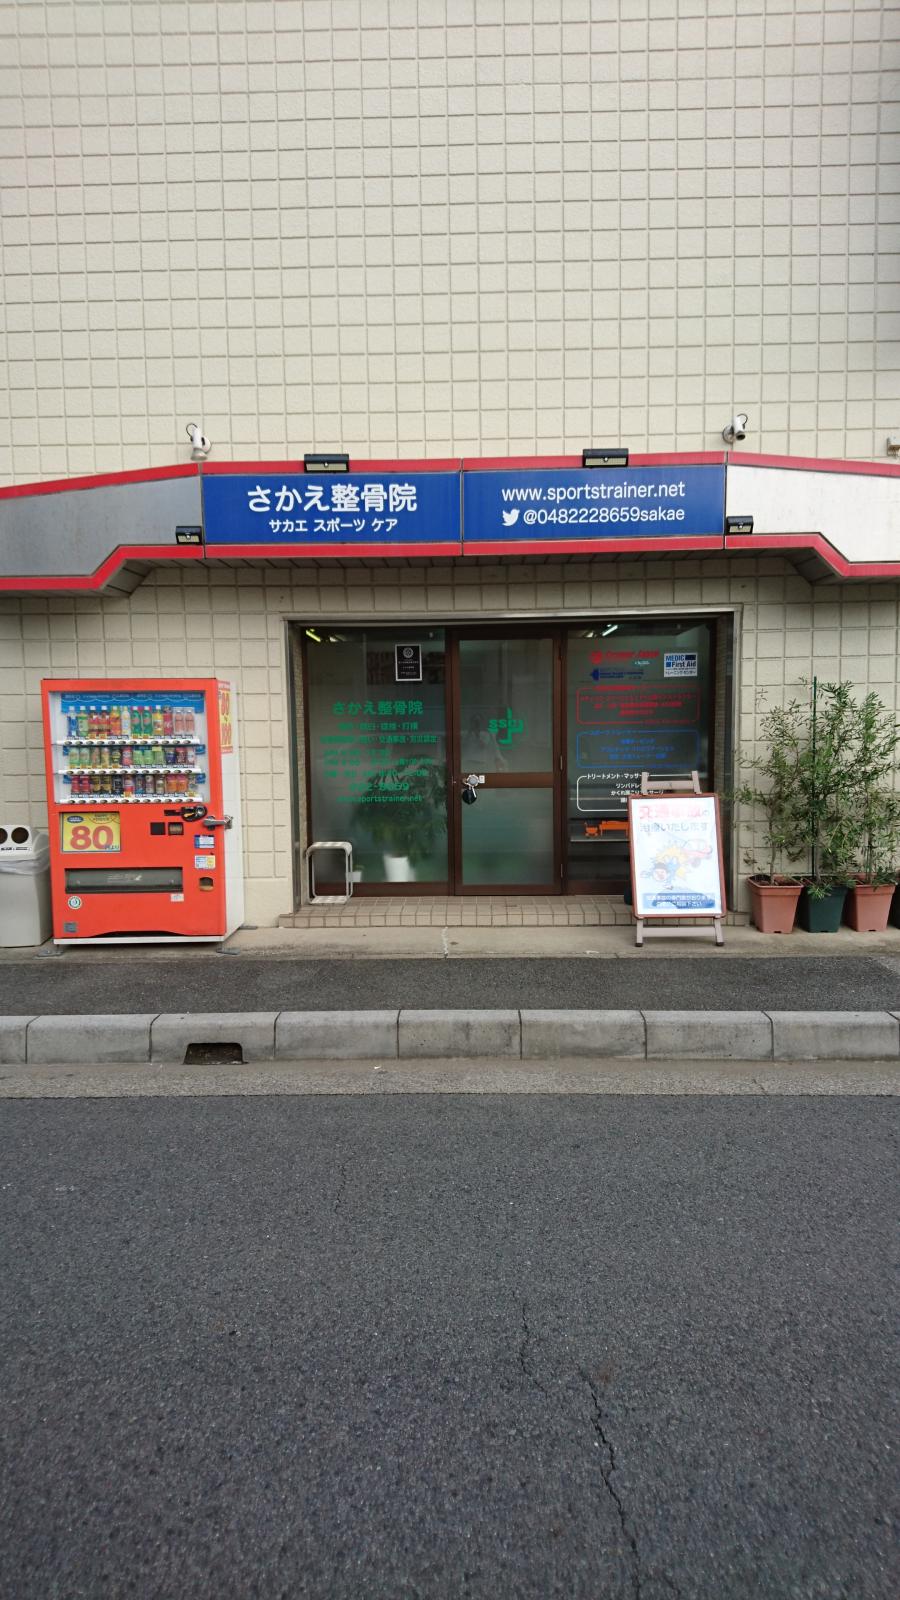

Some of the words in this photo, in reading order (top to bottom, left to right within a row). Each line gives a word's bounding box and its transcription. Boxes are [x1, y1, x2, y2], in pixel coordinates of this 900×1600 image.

[246, 483, 418, 513] さかえ整骨院
[501, 480, 686, 505] www.sportstrainer.net
[268, 519, 308, 533] サカエ
[313, 518, 366, 533] スポーツ
[371, 517, 398, 532] ケア
[523, 506, 685, 526] @0482228659sakae
[666, 654, 685, 662] MEDIC
[332, 700, 424, 716] さかえ整骨院
[69, 825, 114, 850] 80
